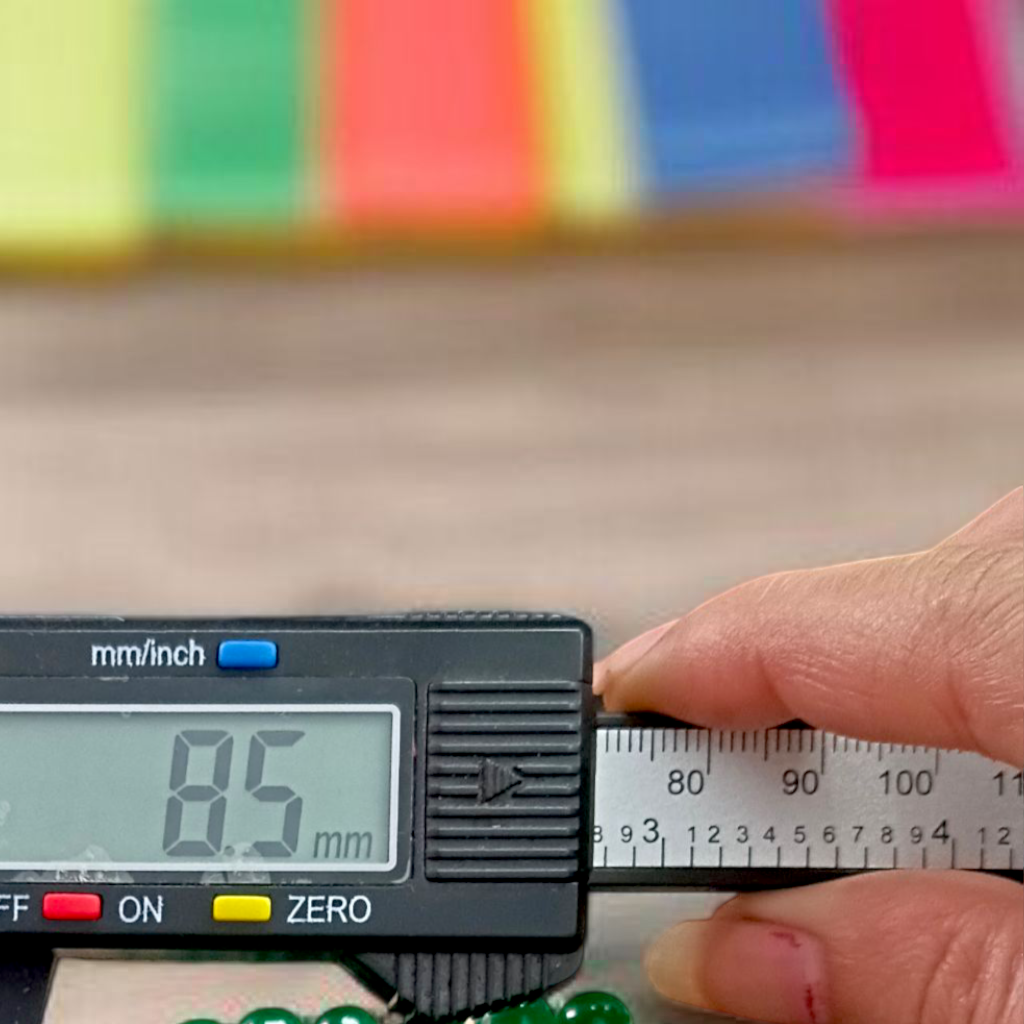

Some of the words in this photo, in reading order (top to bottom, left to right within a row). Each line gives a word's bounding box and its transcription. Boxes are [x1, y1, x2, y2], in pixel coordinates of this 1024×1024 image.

[91, 637, 206, 667] mm/inch
[667, 769, 705, 795] 80
[782, 769, 819, 796] 90
[878, 769, 934, 796] 100
[313, 830, 373, 859] mm
[620, 825, 633, 843] 9
[642, 817, 660, 844] 3
[687, 825, 696, 843] 1
[708, 825, 721, 843] 2
[736, 825, 749, 843] 3
[763, 826, 776, 843] 4
[793, 825, 806, 843] 5
[822, 825, 836, 844] 6
[851, 825, 864, 844] 7
[880, 825, 894, 844] 8
[910, 825, 924, 844] 9
[931, 818, 950, 845] 4
[978, 826, 987, 845] 1
[997, 826, 1011, 845] 2
[118, 895, 164, 923] ON
[286, 894, 372, 924] ZERO
